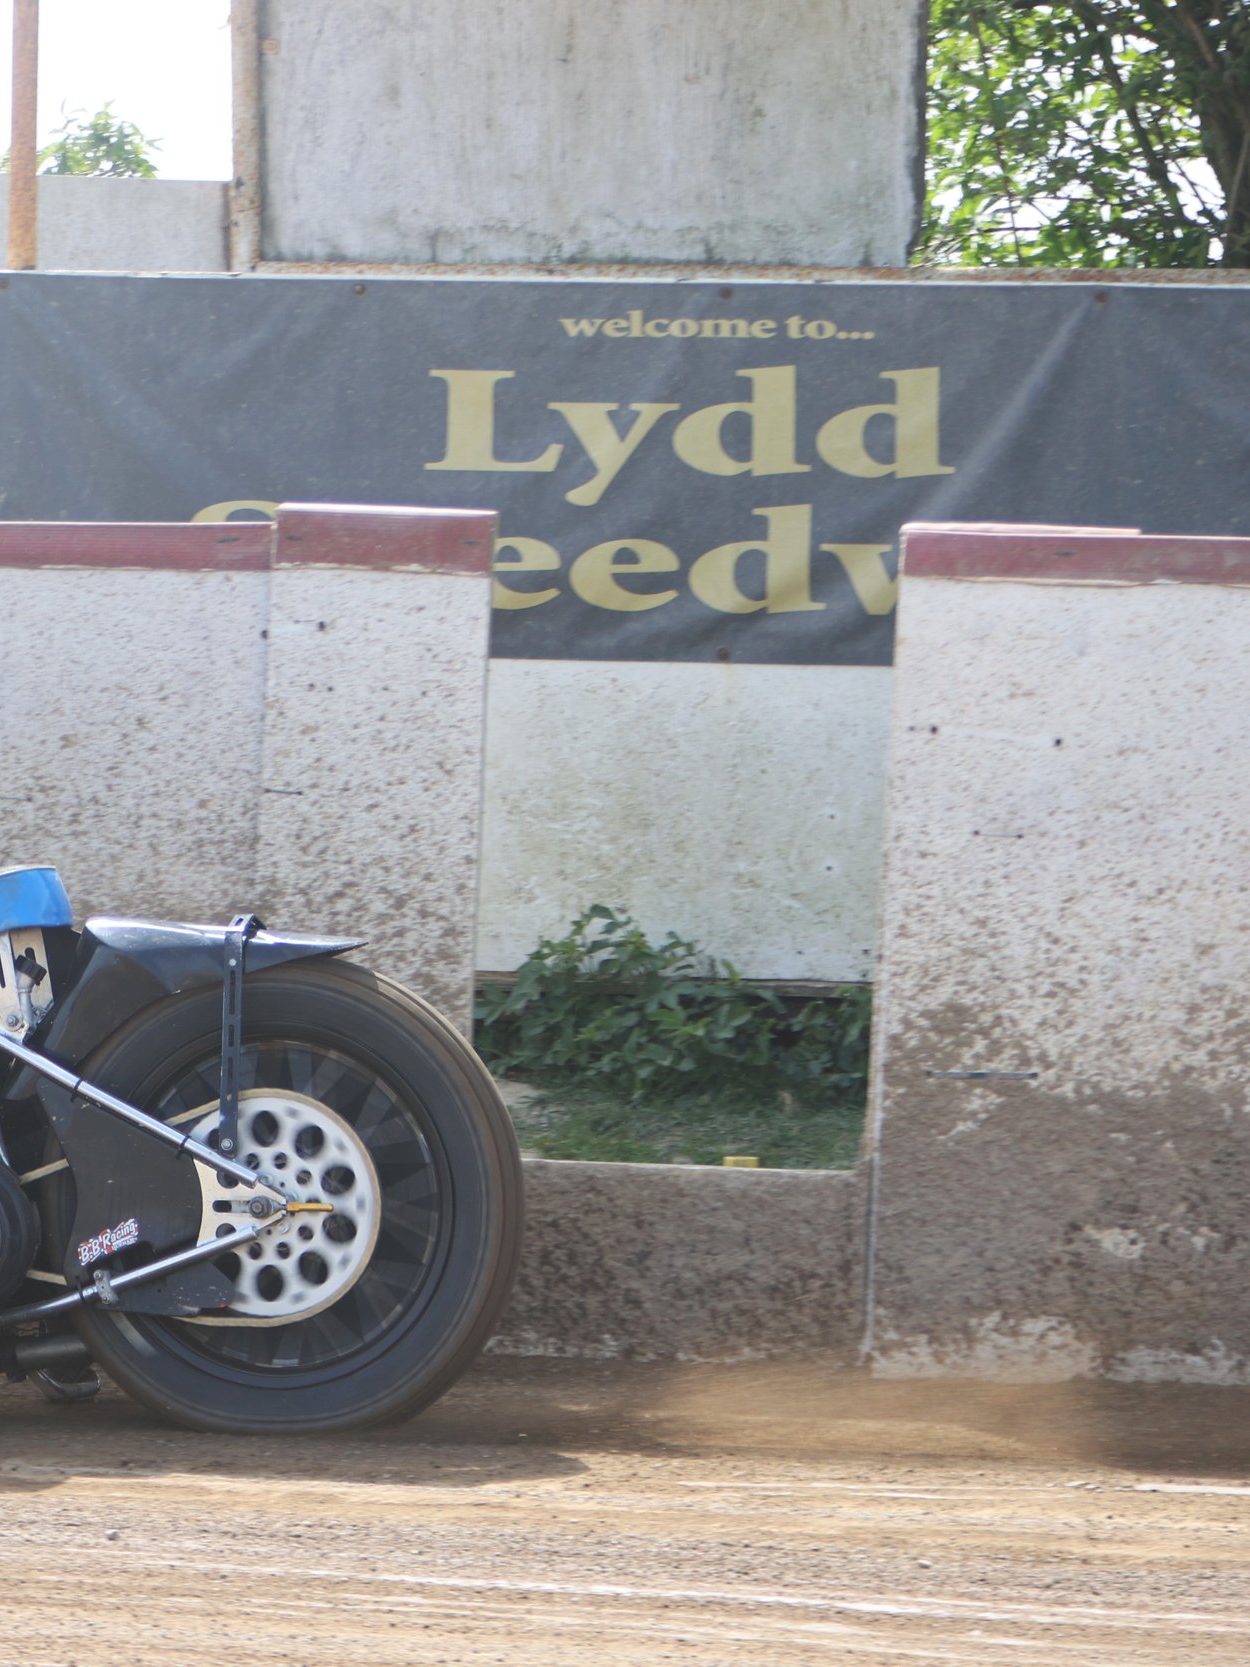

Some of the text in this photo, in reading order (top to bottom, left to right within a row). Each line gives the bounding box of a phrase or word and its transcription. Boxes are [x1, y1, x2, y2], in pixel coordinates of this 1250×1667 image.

[559, 310, 875, 341] welcome to...
[424, 365, 956, 506] Lydd
